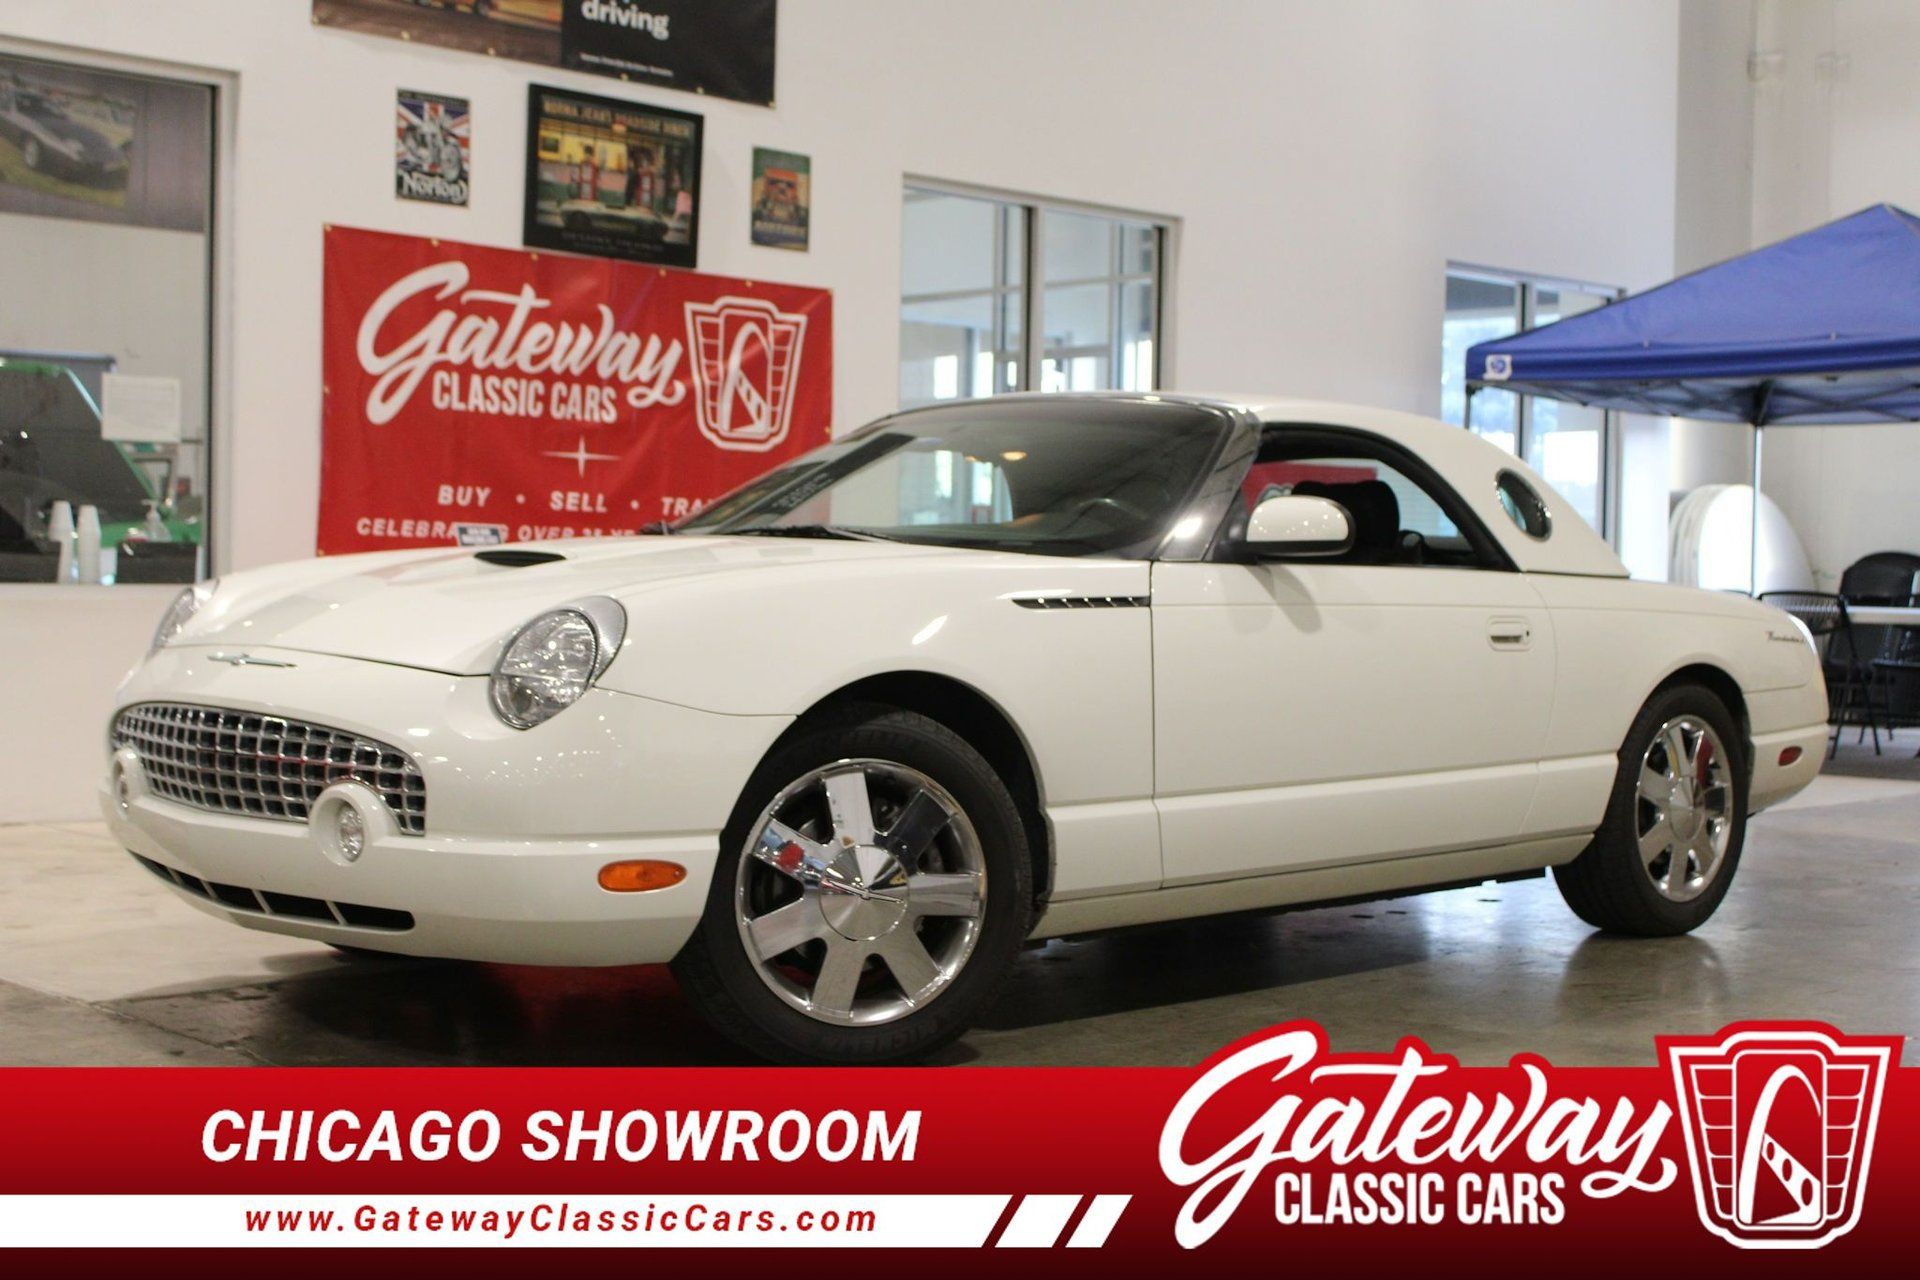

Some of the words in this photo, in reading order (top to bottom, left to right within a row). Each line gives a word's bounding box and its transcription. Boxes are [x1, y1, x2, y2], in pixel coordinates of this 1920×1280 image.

[581, 0, 669, 40] driving
[398, 168, 468, 204] Norton
[356, 261, 685, 425] Gateway
[432, 370, 543, 416] CLASSIC
[549, 381, 618, 424] CARS
[437, 485, 491, 507] BUY
[549, 490, 608, 513] SELL
[660, 496, 711, 517] TRA
